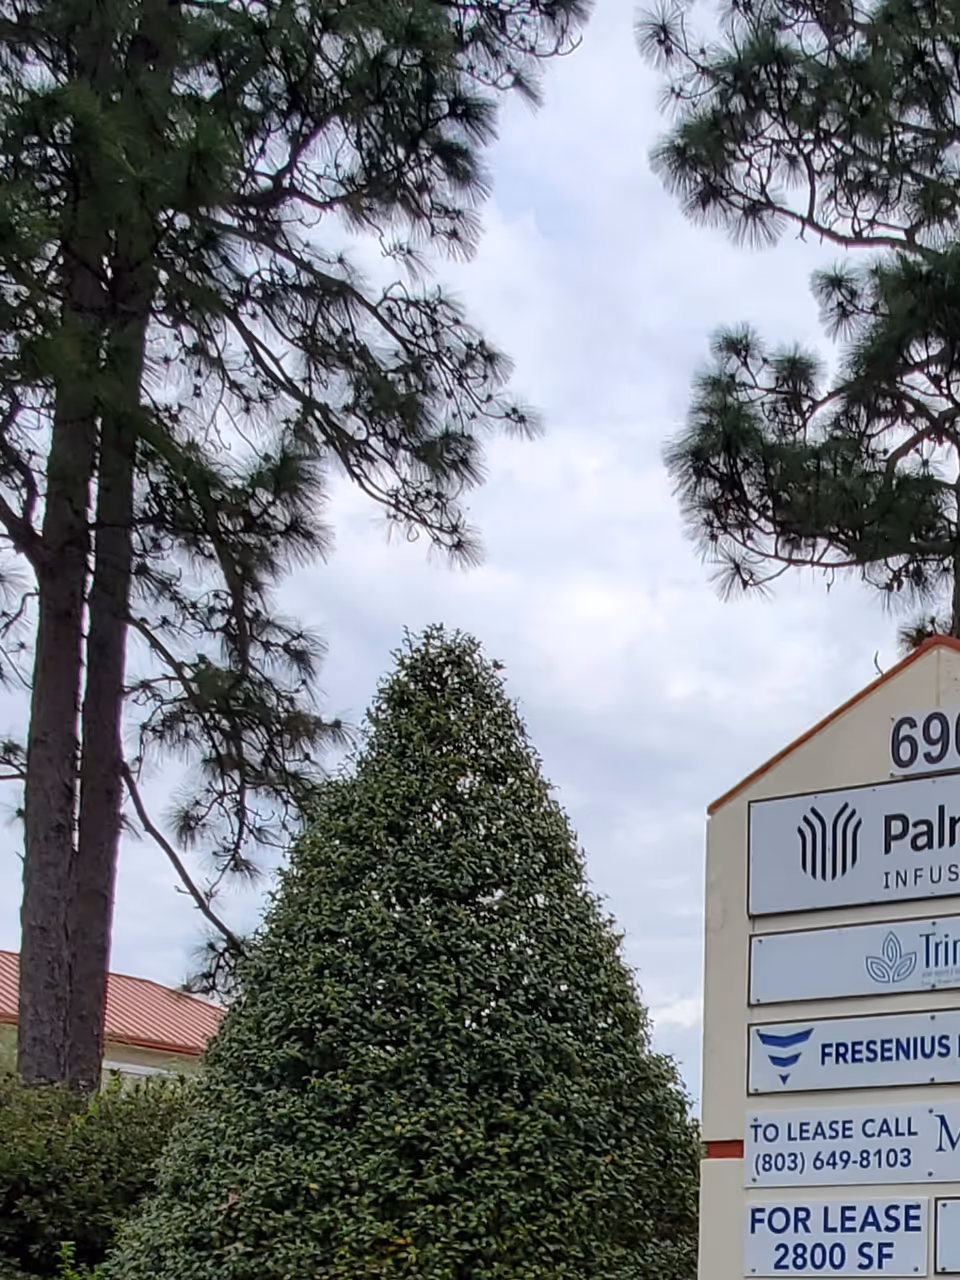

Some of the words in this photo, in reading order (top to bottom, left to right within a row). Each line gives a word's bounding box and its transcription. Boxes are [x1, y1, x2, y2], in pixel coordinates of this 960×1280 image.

[820, 1034, 951, 1066] FRESENIUS
[750, 1123, 780, 1143] TO
[786, 1119, 854, 1142] LEASE
[861, 1116, 918, 1139] CALL
[754, 1151, 805, 1176] (803)
[812, 1147, 912, 1171] 649-8103
[750, 1206, 812, 1234] FOR
[822, 1203, 922, 1233] LEASE
[774, 1242, 847, 1270] 2800
[857, 1241, 895, 1272] SF
